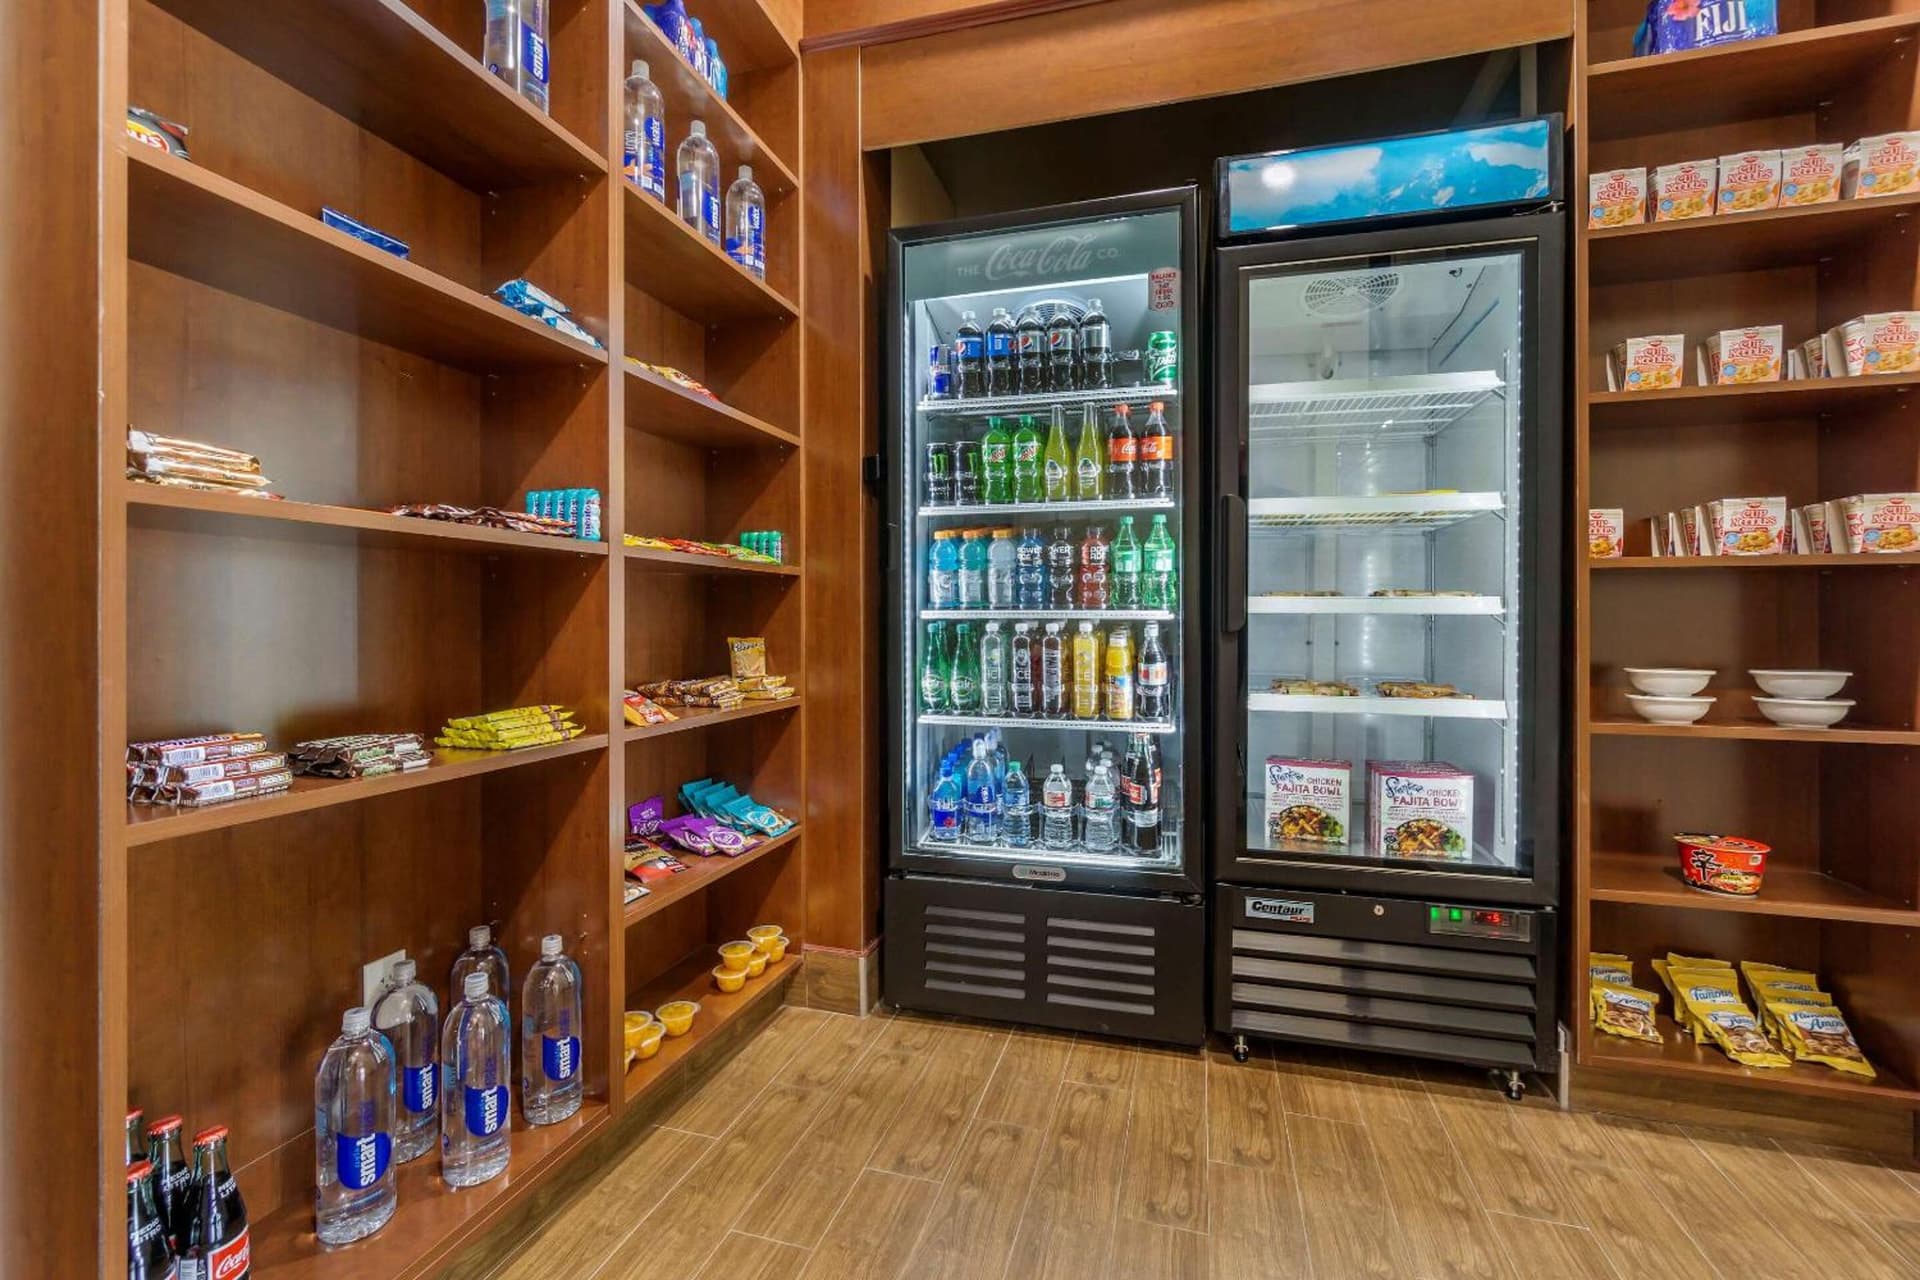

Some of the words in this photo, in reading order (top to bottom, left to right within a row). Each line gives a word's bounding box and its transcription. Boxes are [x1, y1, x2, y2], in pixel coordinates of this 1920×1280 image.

[1695, 1, 1747, 41] FIJI
[531, 32, 543, 80] smart
[1276, 783, 1310, 794] FAJITA
[1312, 785, 1342, 796] BOWL
[1306, 777, 1343, 786] CHICKEN
[1393, 796, 1430, 807] FAJITA
[1252, 901, 1305, 915] Centaur
[556, 1036, 571, 1079] smart
[419, 1063, 433, 1110] smart
[481, 1086, 498, 1134] smart
[355, 1133, 376, 1187] smart
